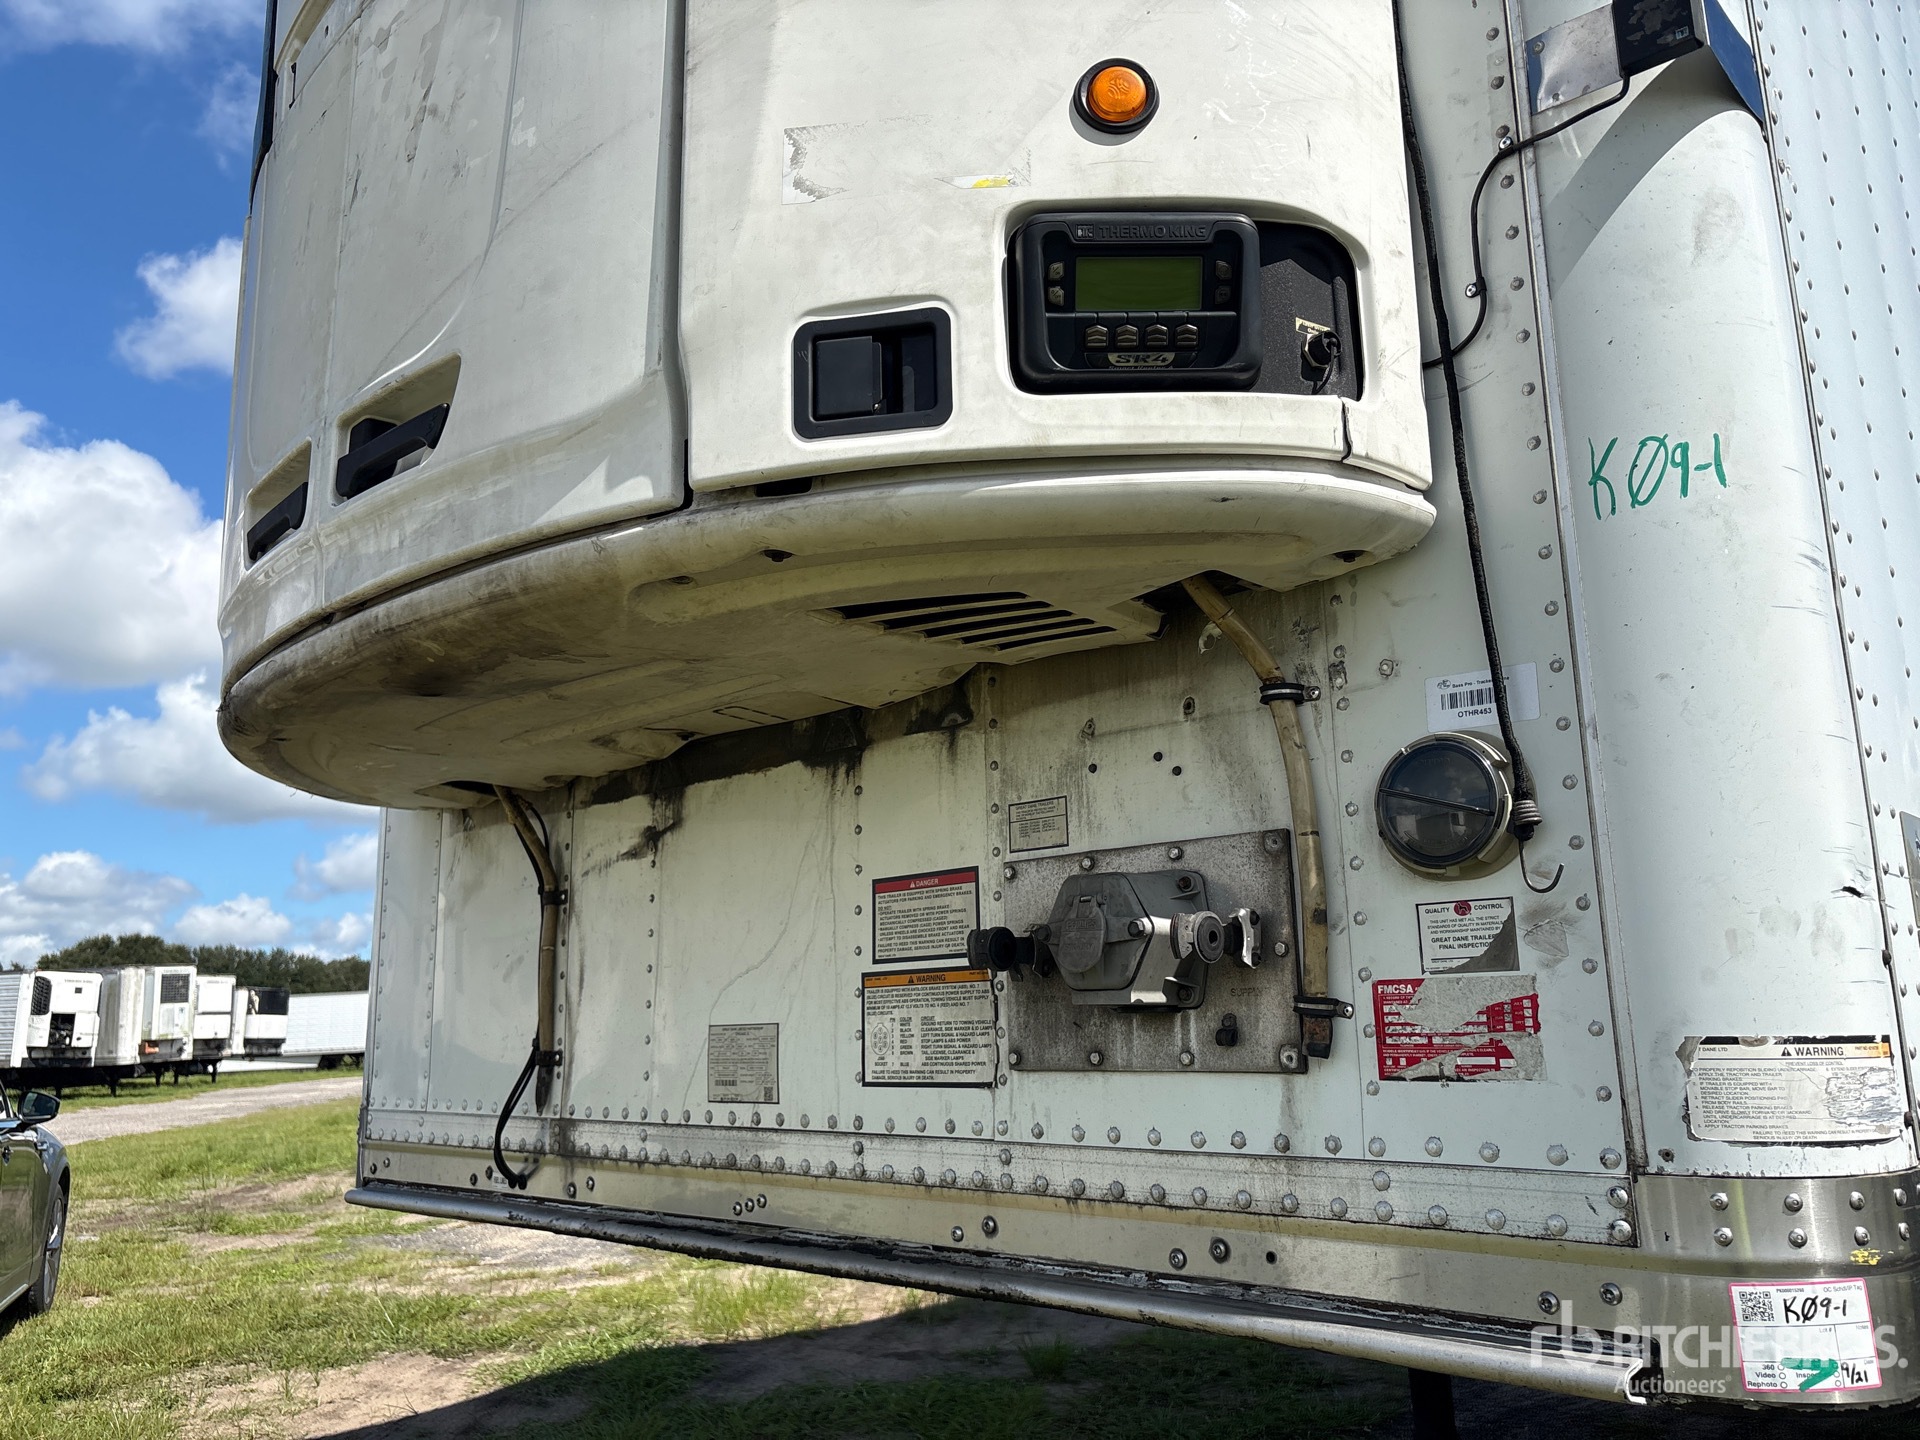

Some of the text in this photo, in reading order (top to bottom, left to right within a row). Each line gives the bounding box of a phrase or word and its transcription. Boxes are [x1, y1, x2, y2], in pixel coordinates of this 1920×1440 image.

[1099, 225, 1166, 238] THERMO
[1169, 225, 1206, 238] KING
[1116, 354, 1168, 363] SR4
[1458, 708, 1492, 717] OTHR453
[916, 974, 946, 983] WARNING
[1378, 984, 1414, 994] FMCSA
[1794, 1047, 1844, 1056] WARNING
[1841, 1362, 1868, 1385] 9/21
